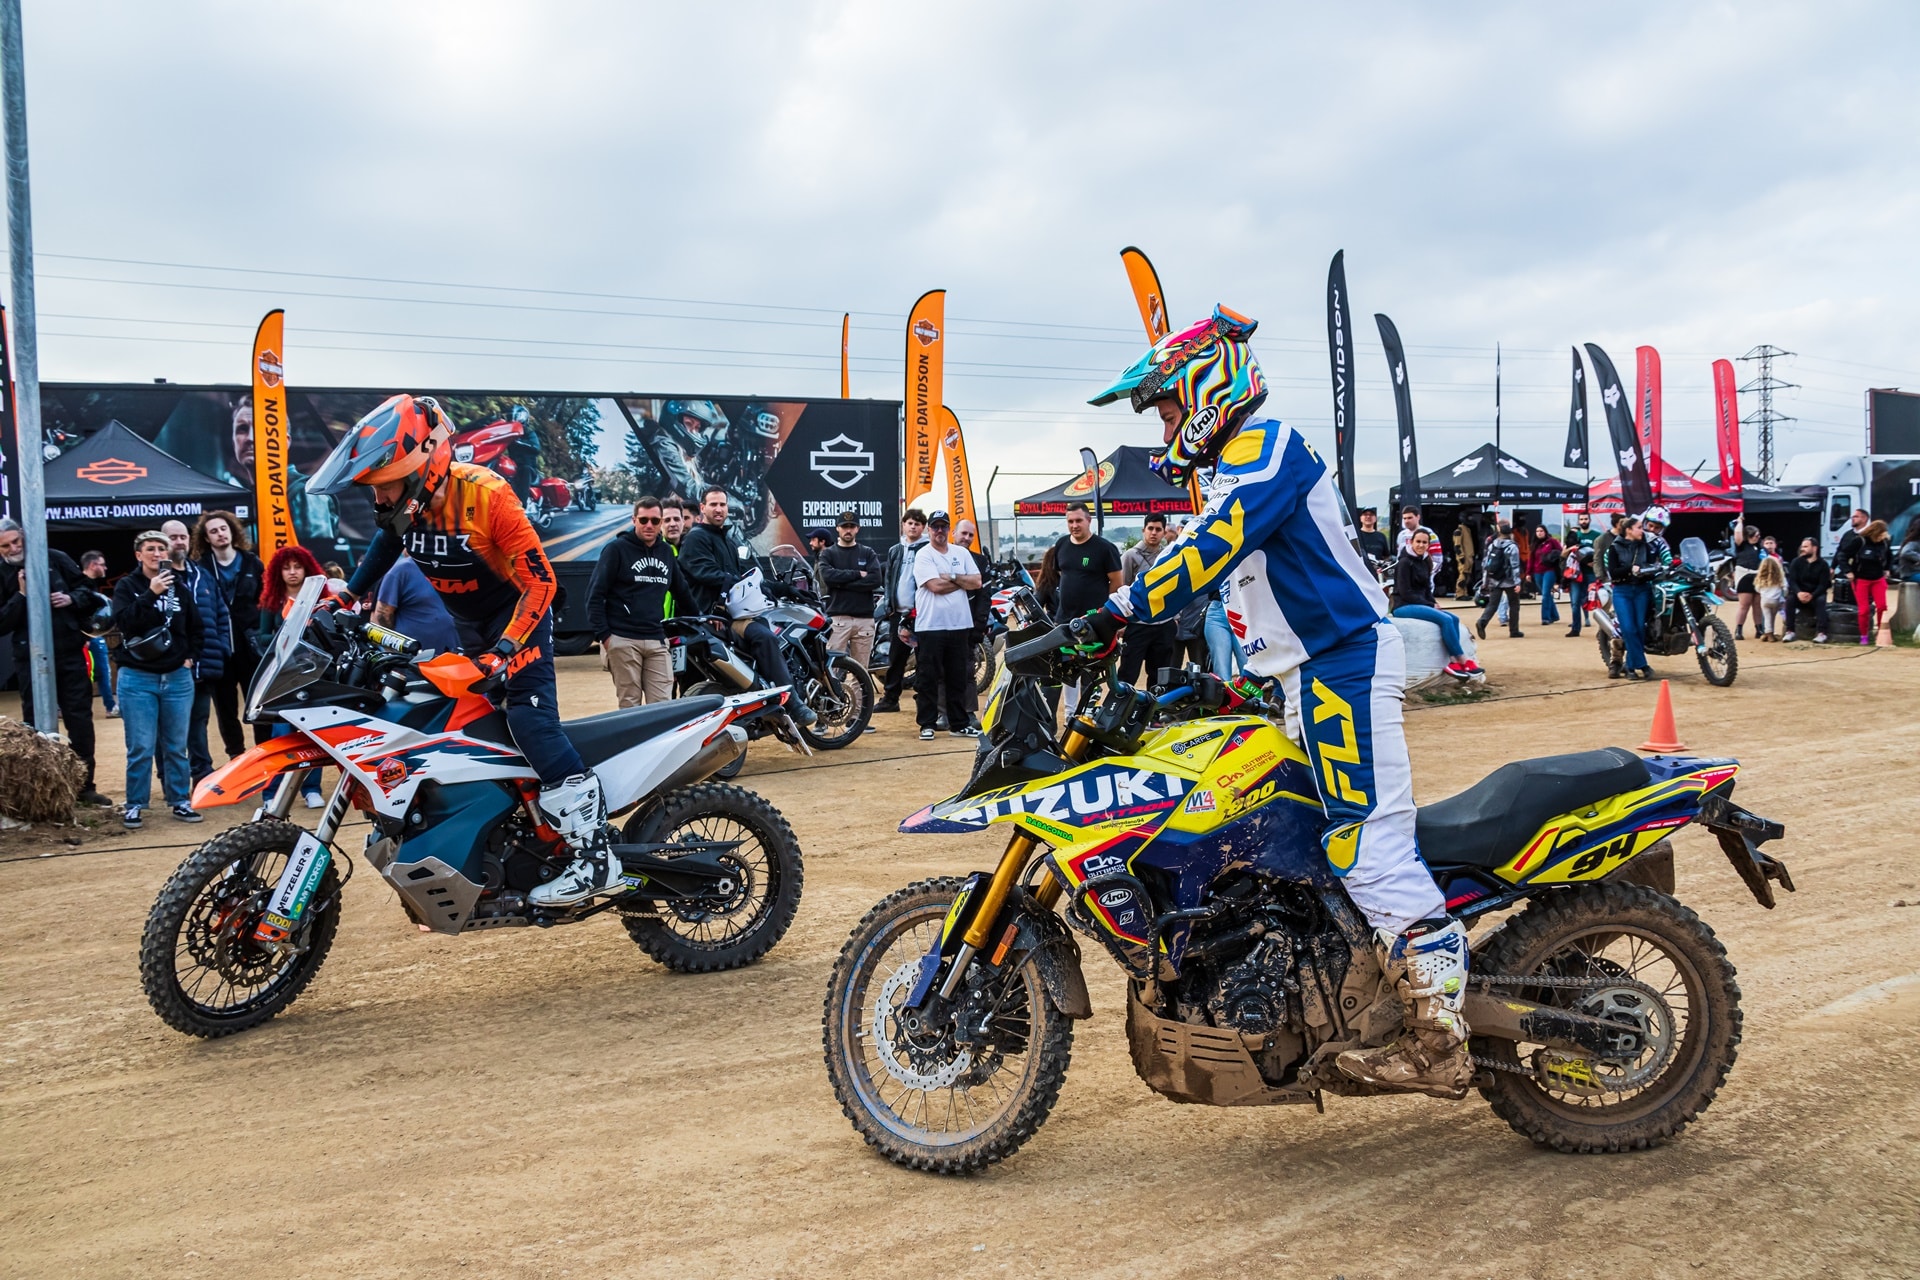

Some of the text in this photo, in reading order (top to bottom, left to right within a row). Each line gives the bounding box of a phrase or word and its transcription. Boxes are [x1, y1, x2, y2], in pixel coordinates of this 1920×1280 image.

[1160, 322, 1221, 375] OAKLEY
[917, 353, 931, 485] HARLEY-DAVIDSON
[1190, 408, 1215, 441] Arai
[264, 398, 288, 550] RLEY-DAVIDSON
[803, 501, 883, 517] EXPERIENCE TOUR
[1019, 501, 1041, 514] ROYAL
[1112, 500, 1148, 514] ROYAL
[1150, 499, 1192, 513] ENFIELD
[808, 518, 836, 527] AMANECER
[872, 518, 883, 527] ERA
[402, 532, 473, 556] HOR
[631, 556, 670, 576] TRIUMPH
[1143, 497, 1245, 618] FLY
[427, 577, 480, 594] KTM
[506, 645, 542, 680] KTM
[1311, 676, 1370, 806] FLY
[1241, 750, 1274, 770] OUTBACK
[391, 798, 406, 807] KTM
[1025, 815, 1074, 843] RABACONDA
[1566, 831, 1640, 879] 94
[299, 853, 328, 903] MOTOREX
[1087, 863, 1126, 879] OUTBACK
[276, 857, 307, 912] METZELER
[1100, 891, 1128, 905] Arai
[266, 913, 292, 929] RODI
